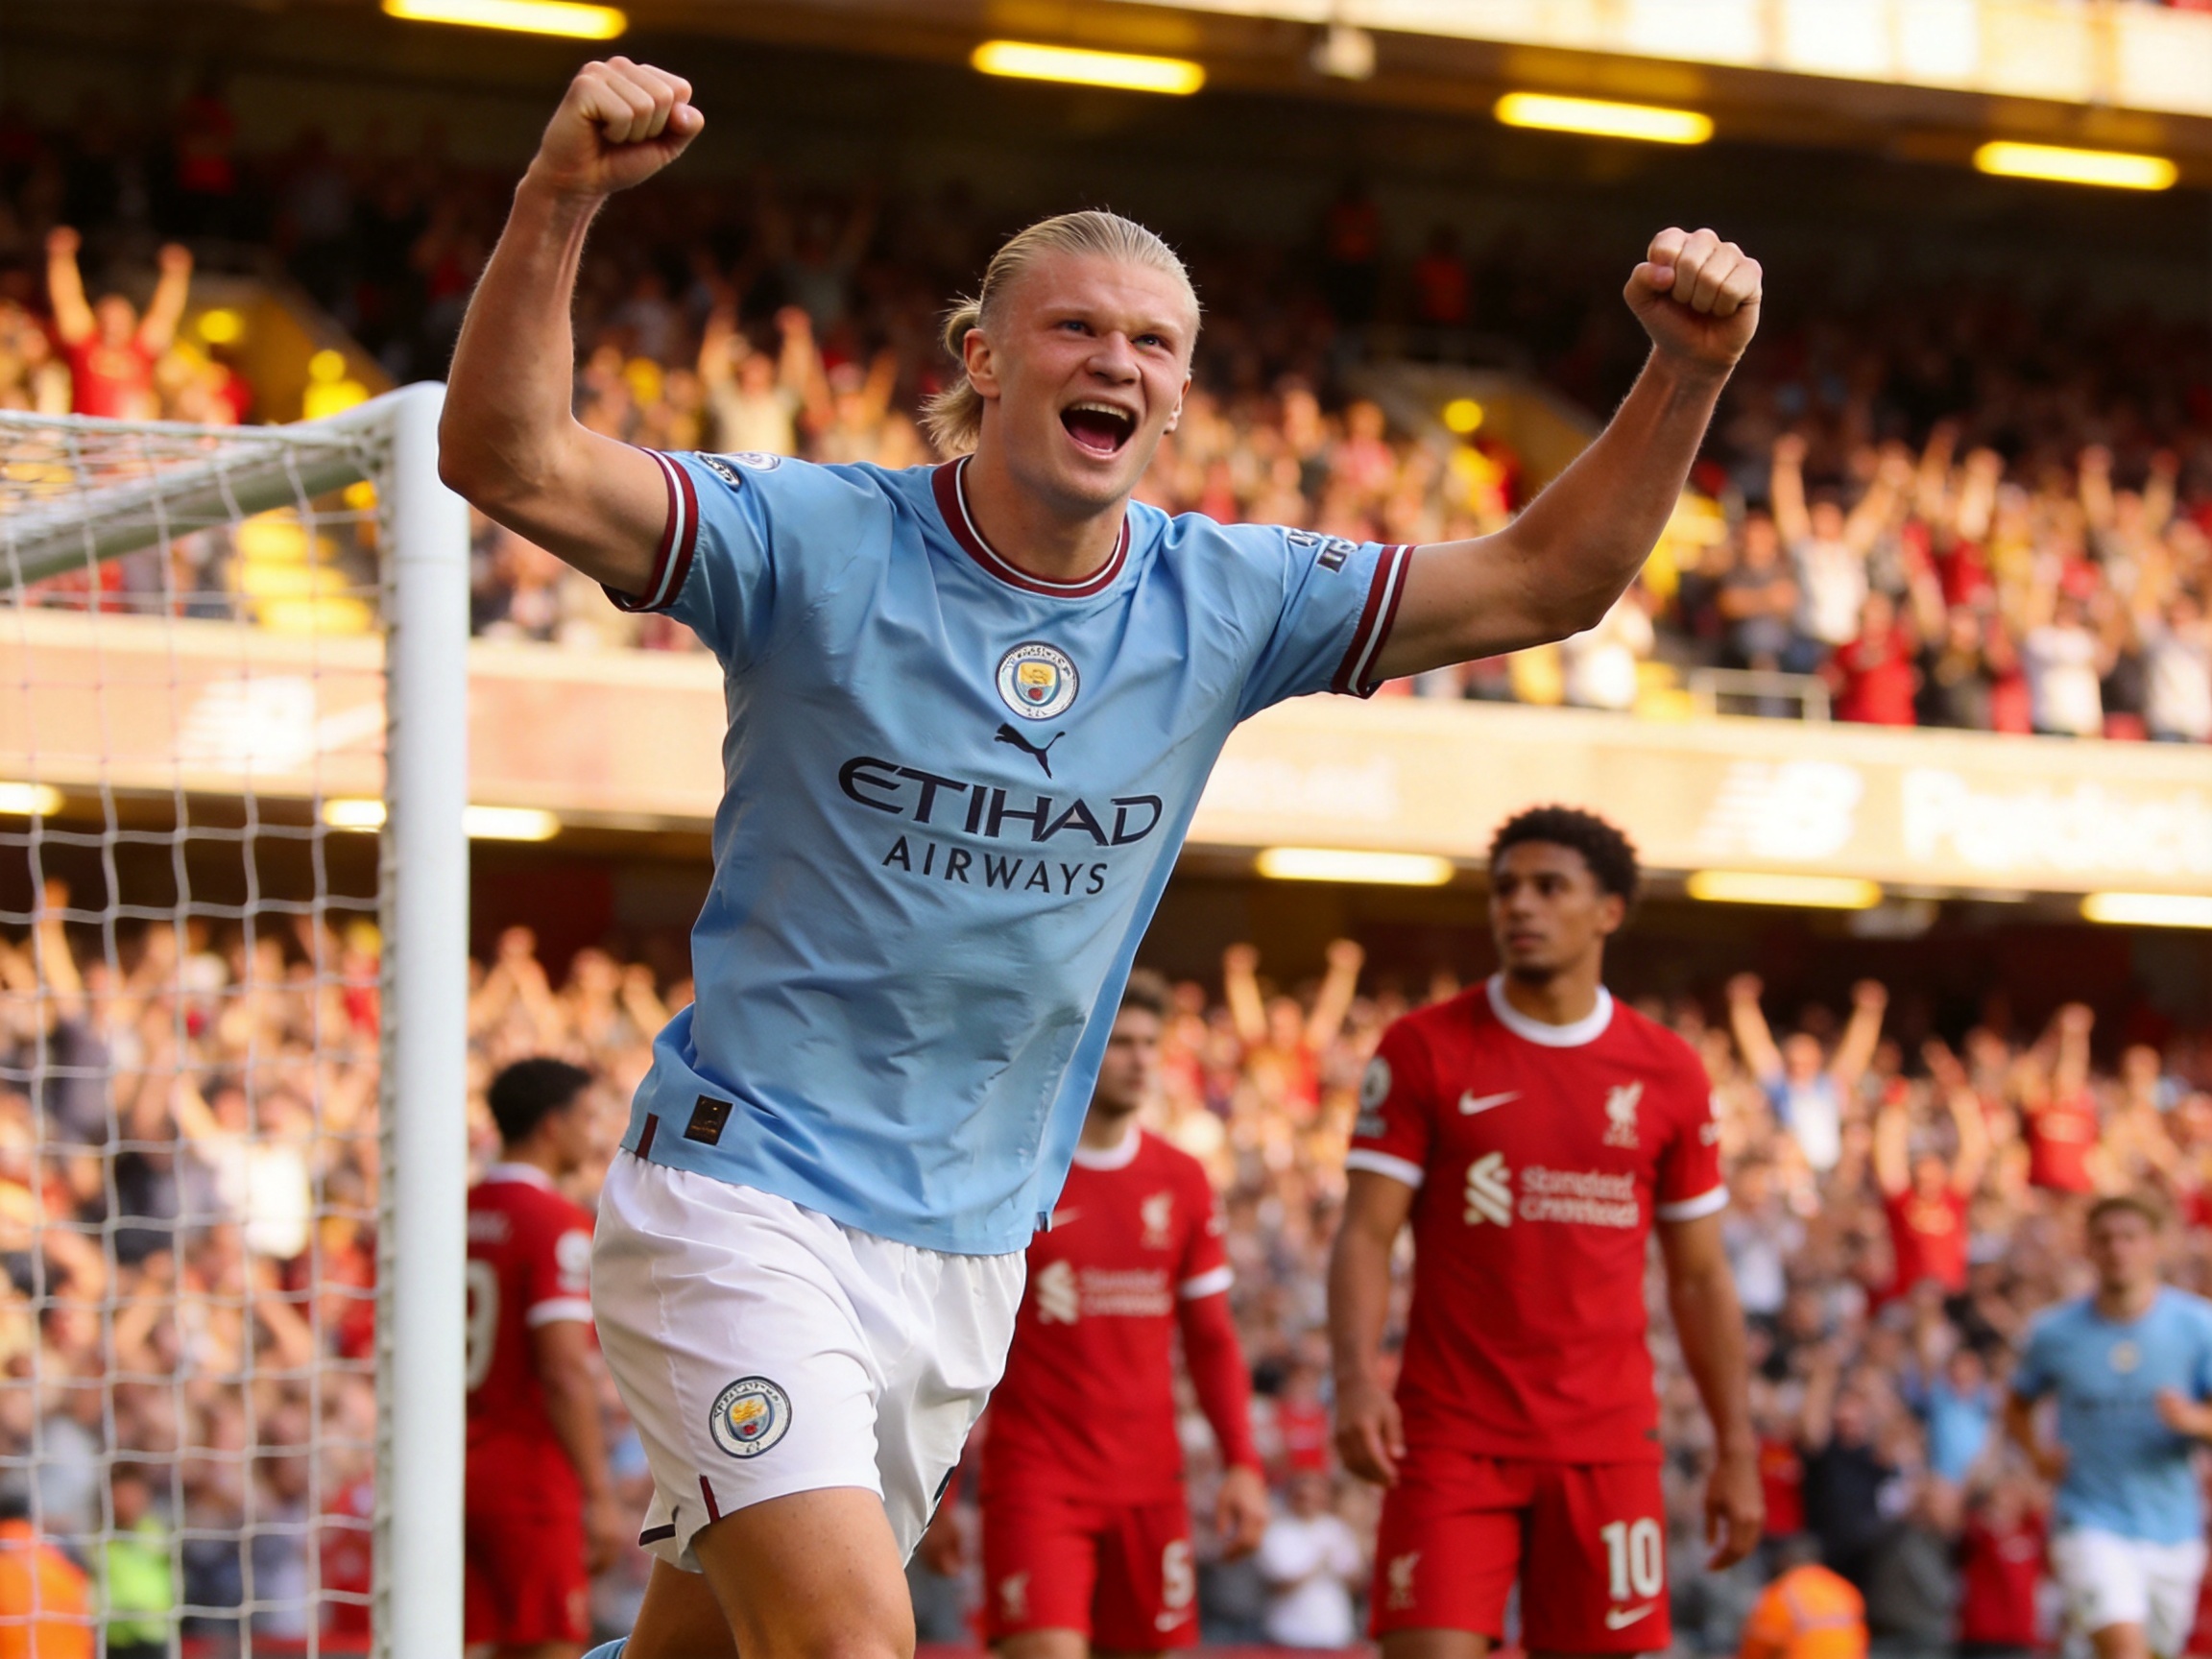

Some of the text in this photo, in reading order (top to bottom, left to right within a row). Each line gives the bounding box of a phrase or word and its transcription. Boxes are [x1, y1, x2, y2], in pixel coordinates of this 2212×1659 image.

[838, 756, 1163, 847] ETIHAD
[881, 834, 1109, 896] AIRWAYS
[1600, 1517, 1664, 1601] 10
